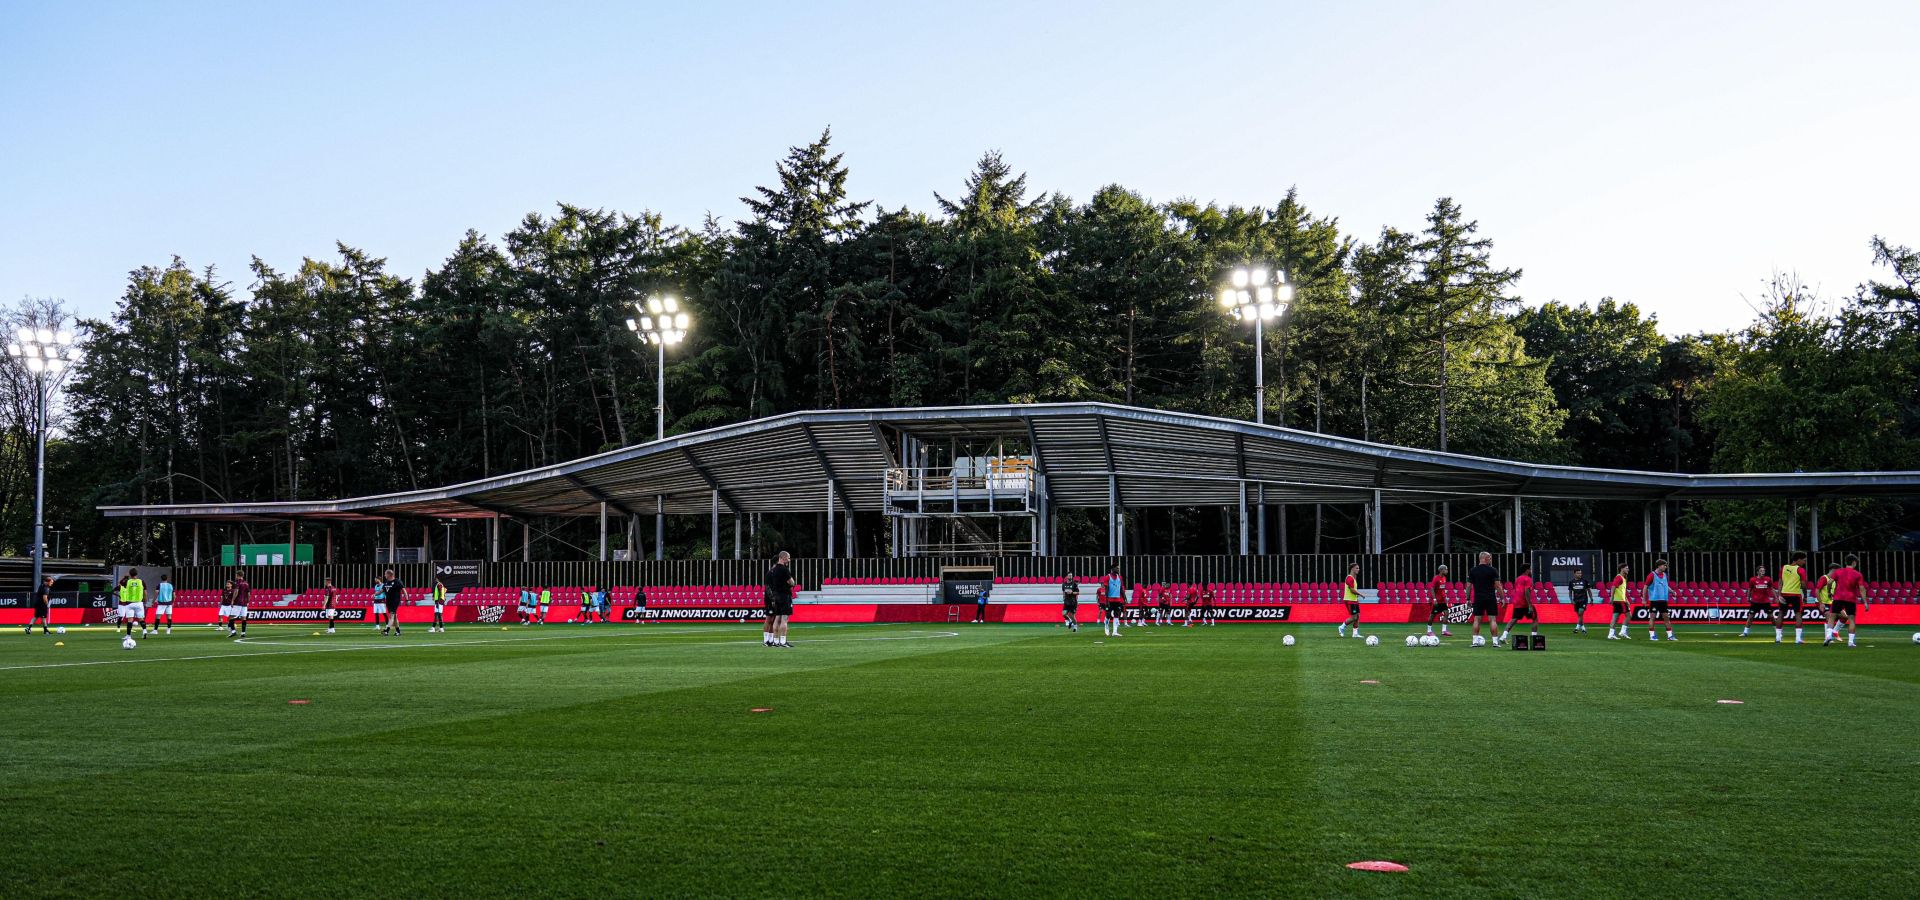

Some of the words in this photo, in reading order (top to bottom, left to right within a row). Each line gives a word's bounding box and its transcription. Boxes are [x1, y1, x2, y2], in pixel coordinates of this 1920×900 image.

[1551, 557, 1584, 566] ASML
[261, 610, 317, 619] INNOVATION
[339, 610, 362, 619] 2025
[626, 609, 660, 618] OEN
[660, 609, 727, 618] INNOVATION
[727, 609, 749, 618] CUP
[1229, 608, 1252, 618] CUP
[1254, 608, 1285, 618] 2025
[1682, 608, 1768, 619] INNVATIN
[1451, 614, 1467, 623] CUP
